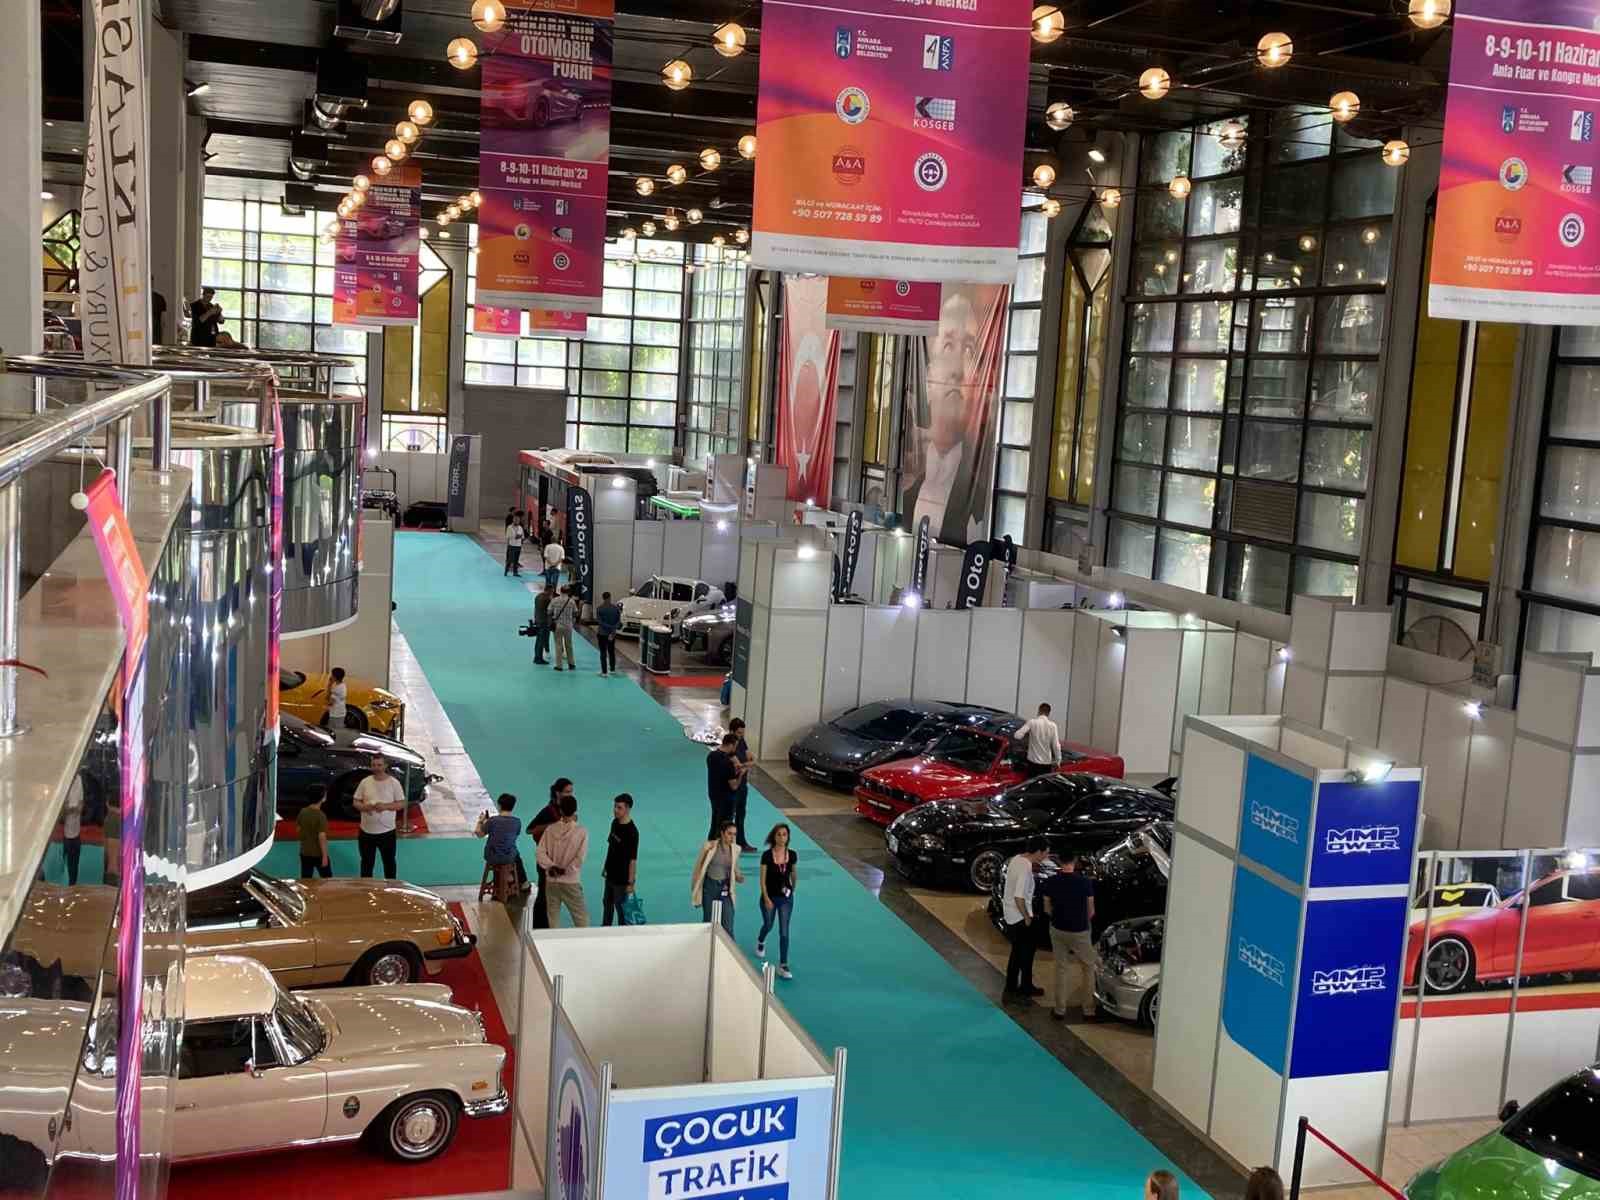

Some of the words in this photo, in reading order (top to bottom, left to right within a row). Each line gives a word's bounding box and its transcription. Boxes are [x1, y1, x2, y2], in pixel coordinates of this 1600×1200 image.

[1485, 34, 1552, 62] 8-9-10-11
[1514, 65, 1537, 81] Fuar
[1537, 68, 1550, 81] ve
[1551, 68, 1581, 85] Kongre
[912, 119, 955, 131] KOSGEB
[792, 207, 811, 218] +90
[813, 210, 833, 220] 507
[869, 214, 882, 224] 89
[966, 552, 985, 591] Oto
[1327, 826, 1400, 842] MMP
[1313, 966, 1386, 984] MMP
[654, 1104, 786, 1158] ÇOCUK
[658, 1149, 780, 1196] TRAFİK
